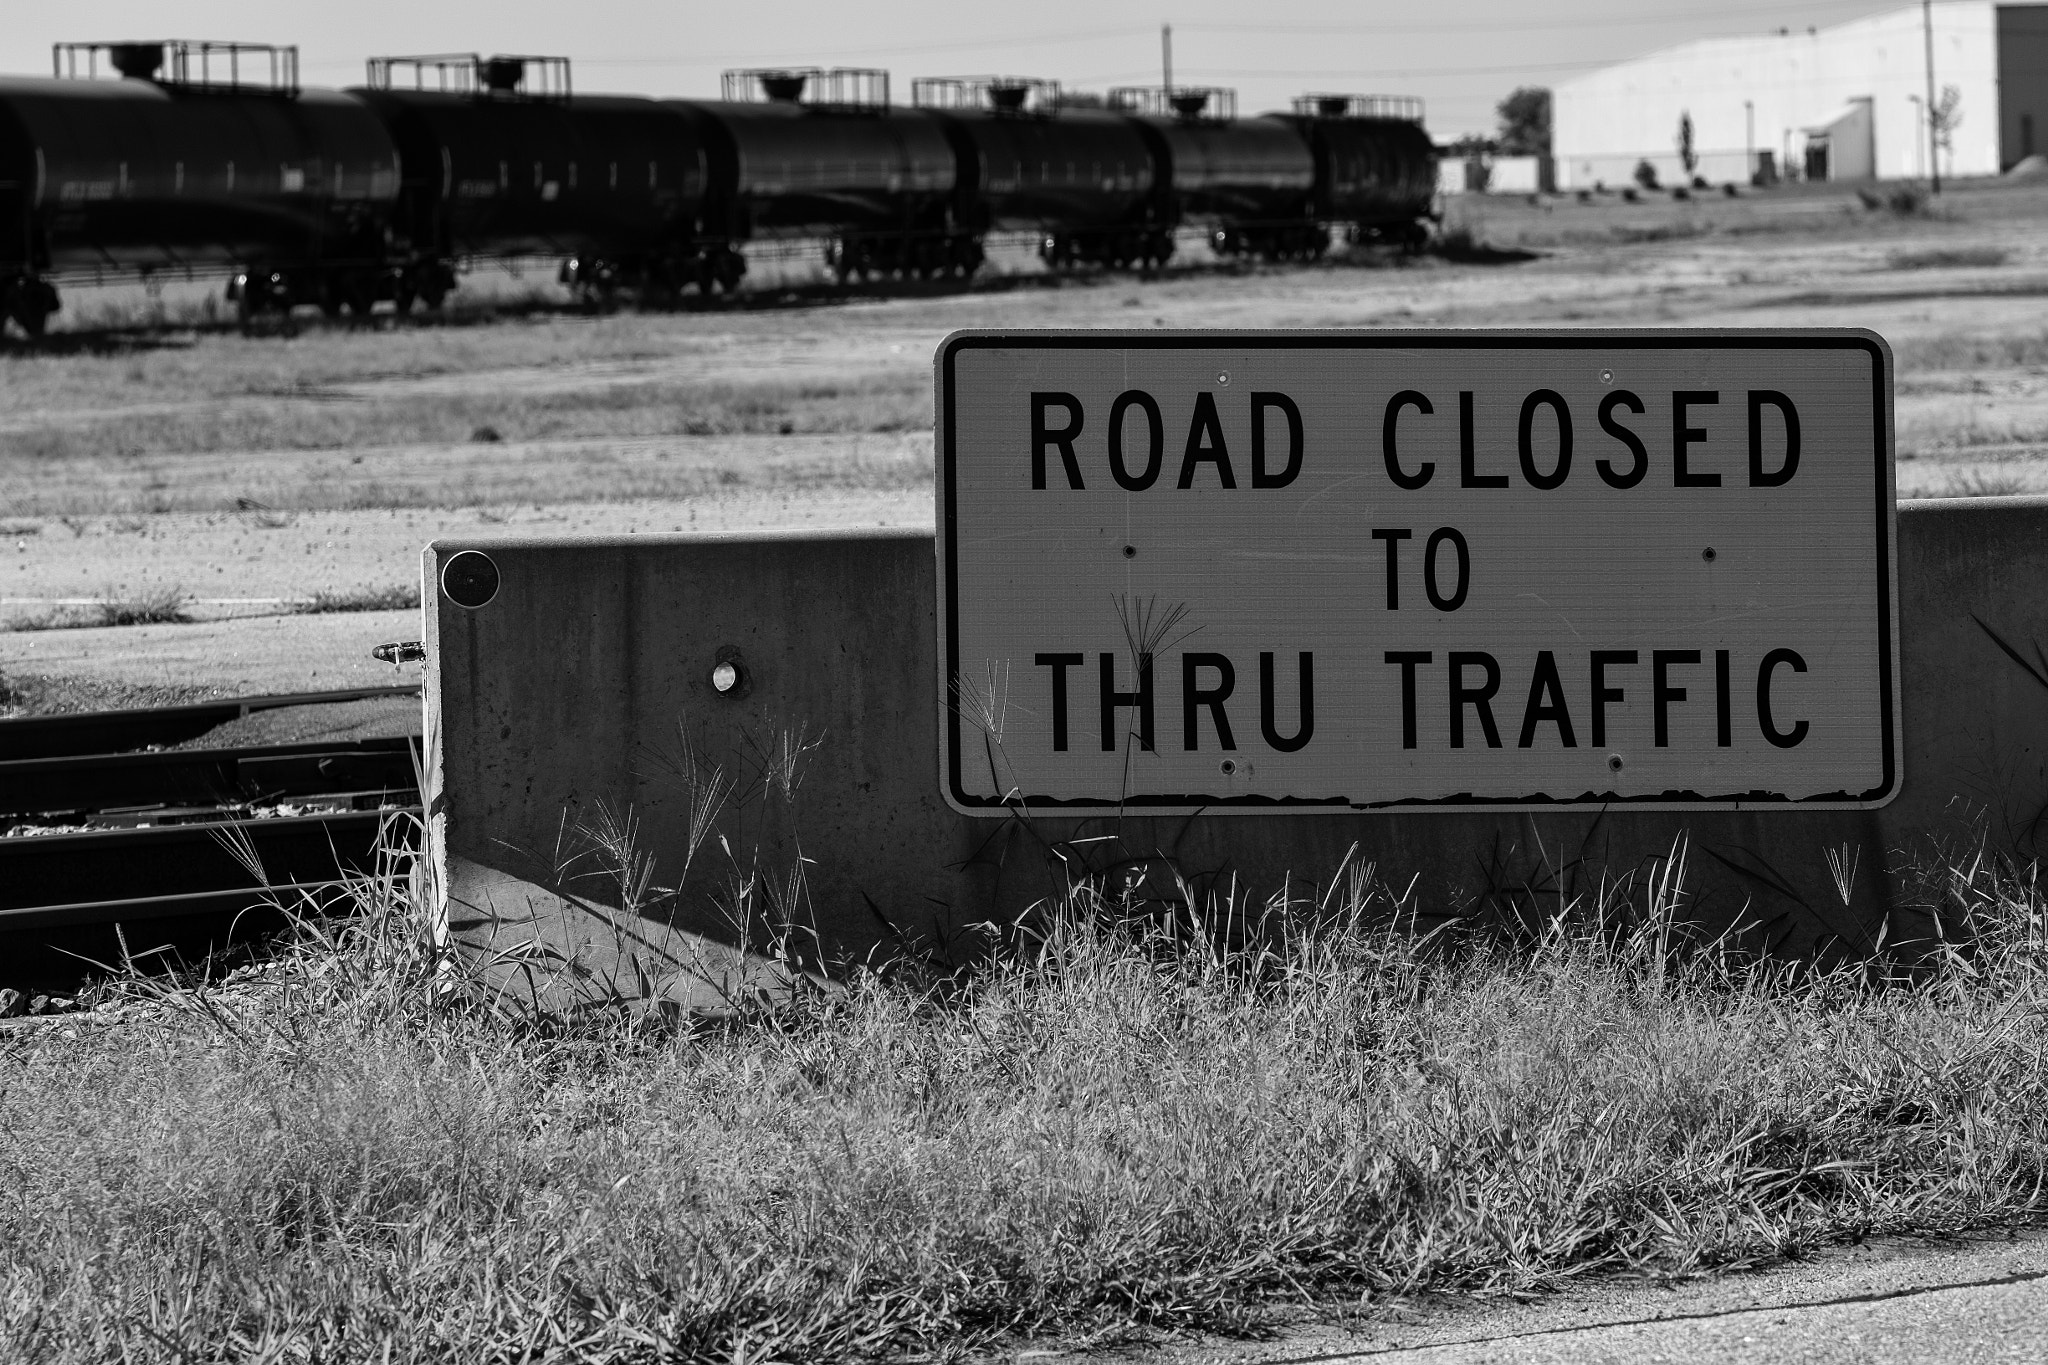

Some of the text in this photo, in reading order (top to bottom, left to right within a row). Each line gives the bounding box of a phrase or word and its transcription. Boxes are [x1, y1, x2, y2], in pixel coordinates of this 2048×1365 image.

[1031, 389, 1801, 491] ROAD CLOSED
[1372, 527, 1470, 612] TO
[1035, 648, 1809, 753] THRU TRAFFIC
